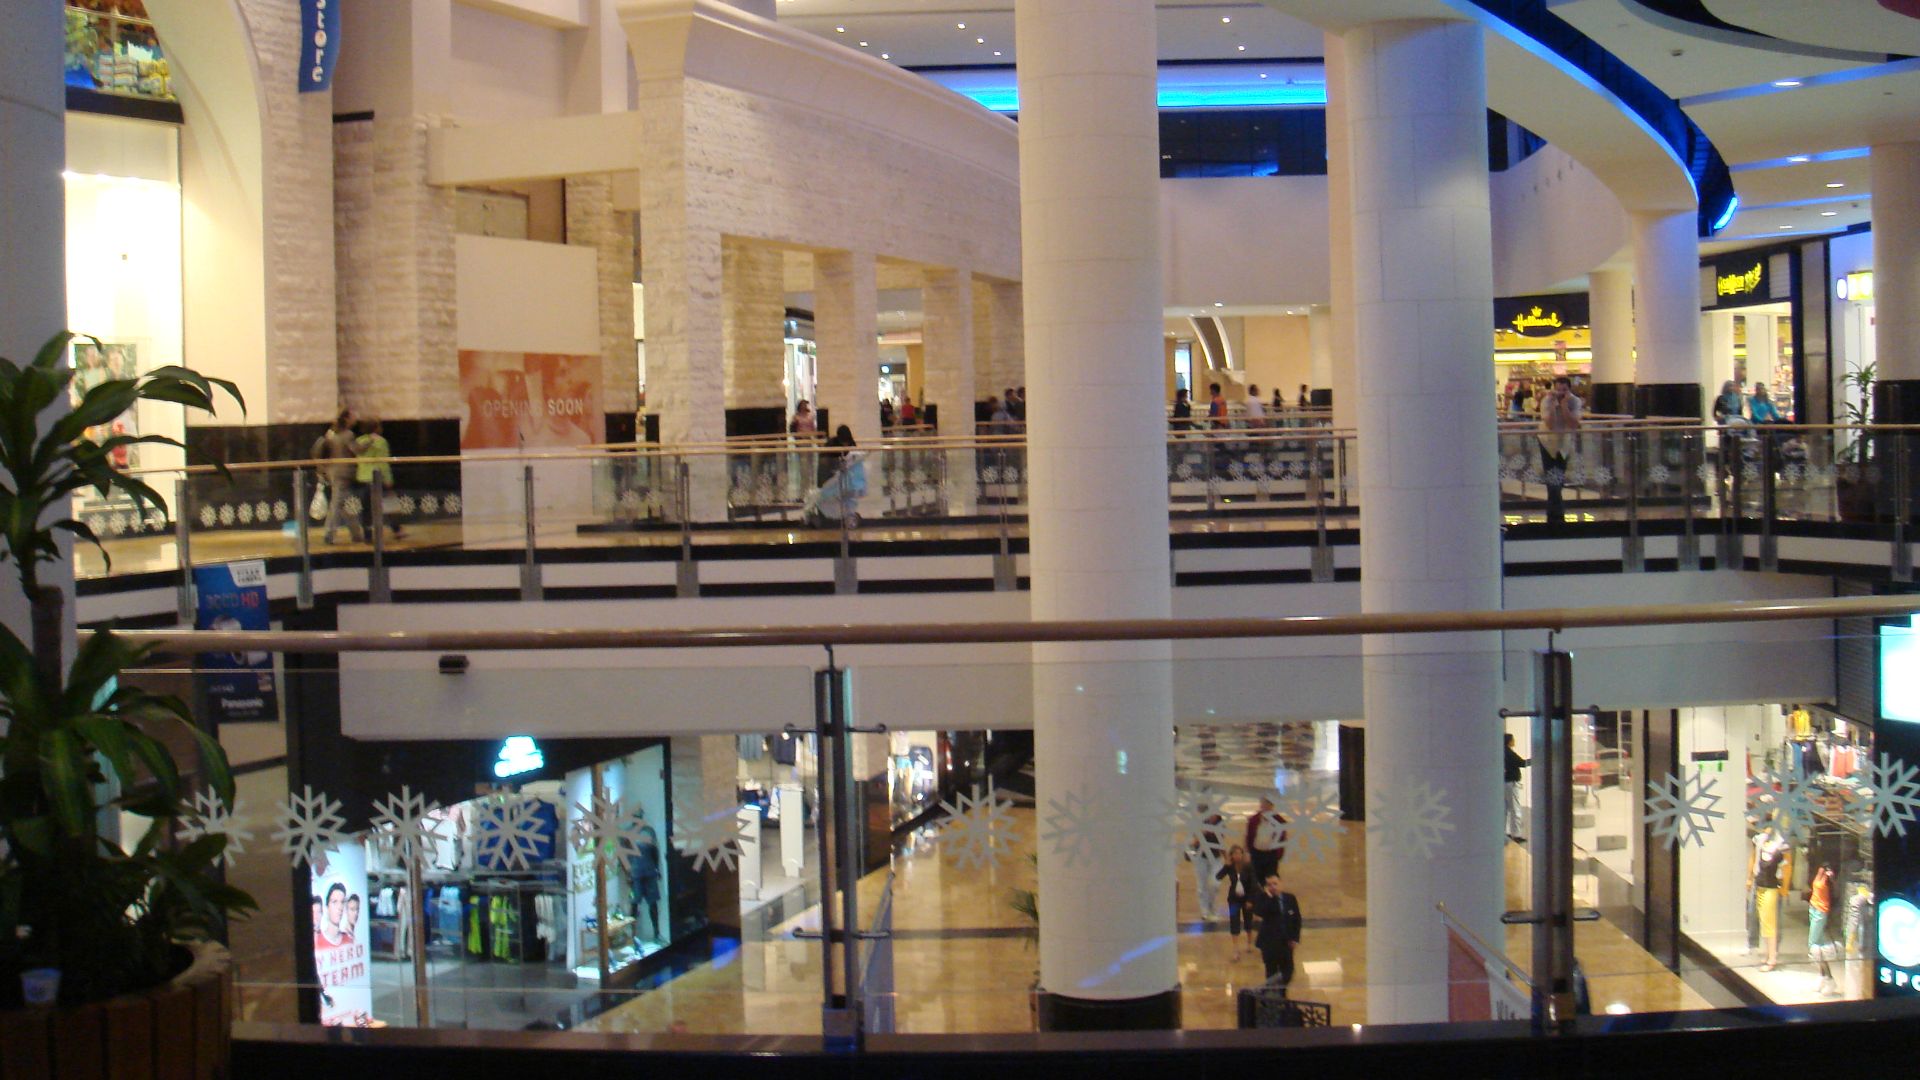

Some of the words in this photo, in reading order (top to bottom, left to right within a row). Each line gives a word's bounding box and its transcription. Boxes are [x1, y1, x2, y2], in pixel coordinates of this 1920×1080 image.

[1512, 312, 1562, 333] Hallmark
[483, 400, 543, 418] OPENIN
[547, 398, 583, 416] SOON
[330, 944, 364, 964] HERO
[322, 962, 364, 989] TEAM
